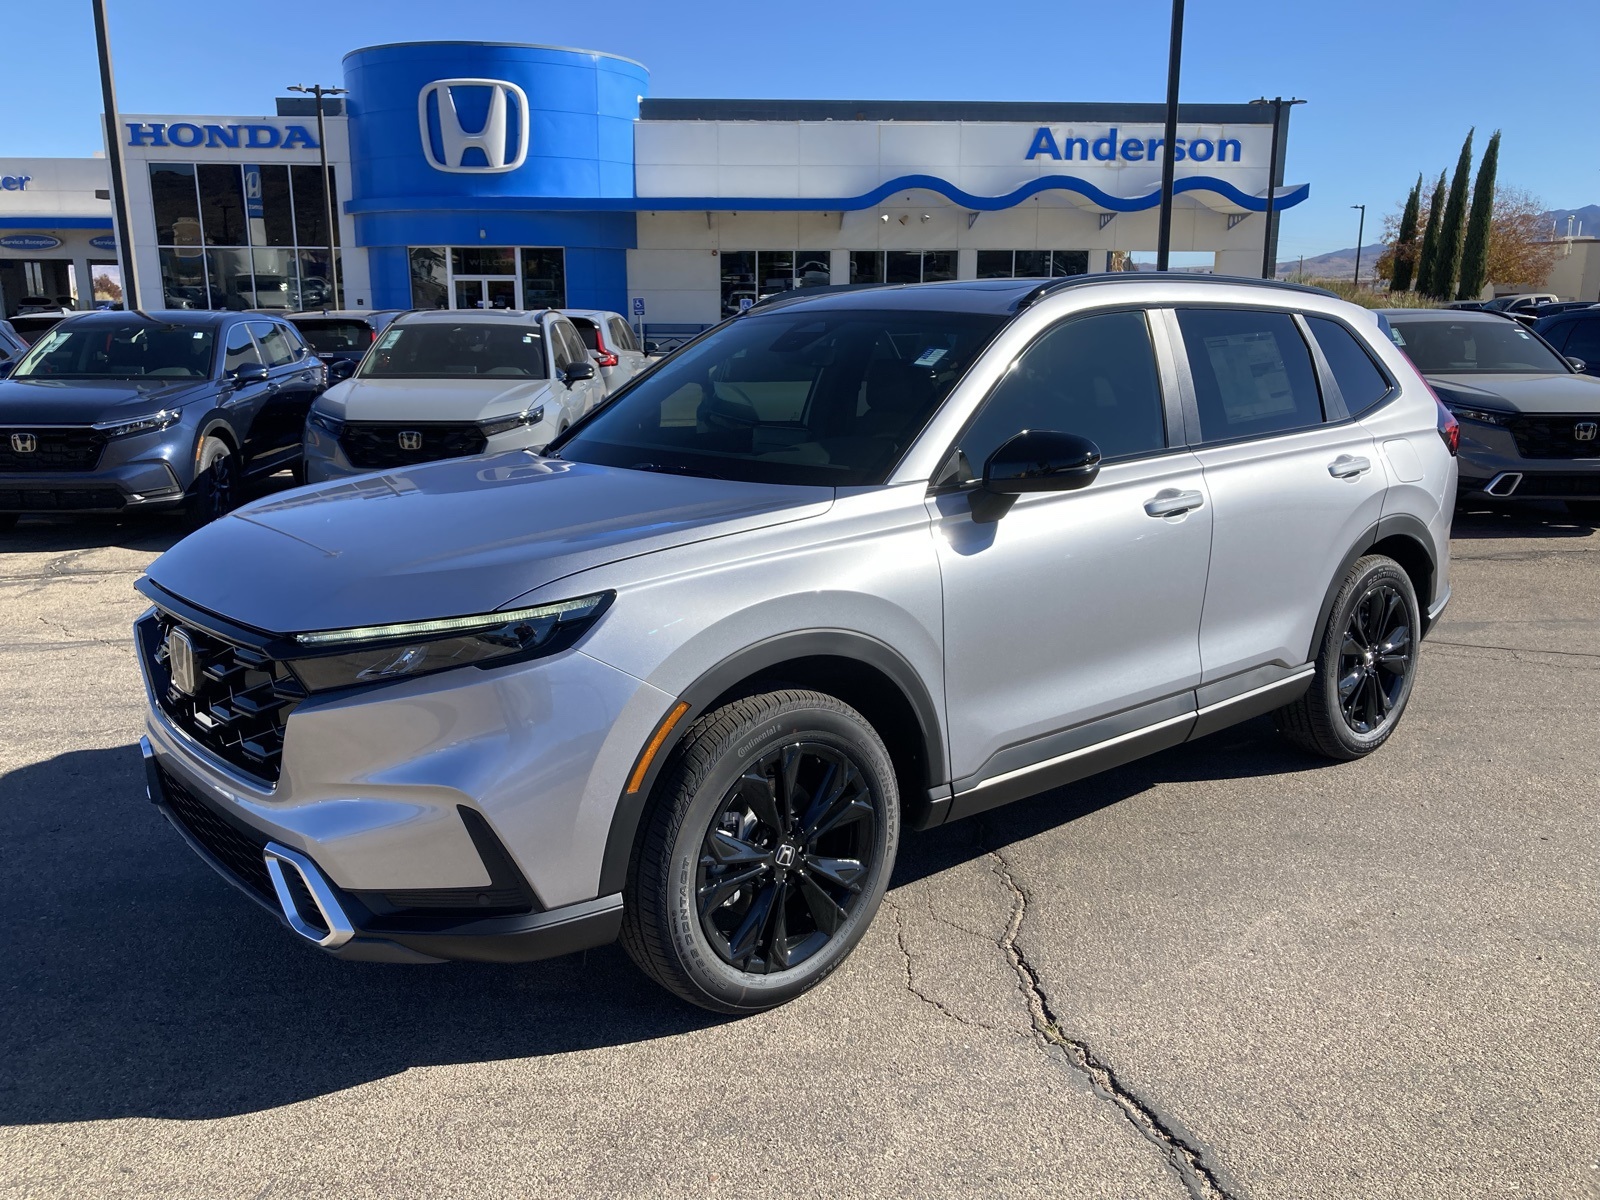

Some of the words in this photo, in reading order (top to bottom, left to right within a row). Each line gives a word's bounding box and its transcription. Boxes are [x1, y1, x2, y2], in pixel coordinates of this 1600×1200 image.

[126, 123, 320, 149] HONDA
[1025, 126, 1242, 163] Anderson
[737, 725, 777, 758] Continental
